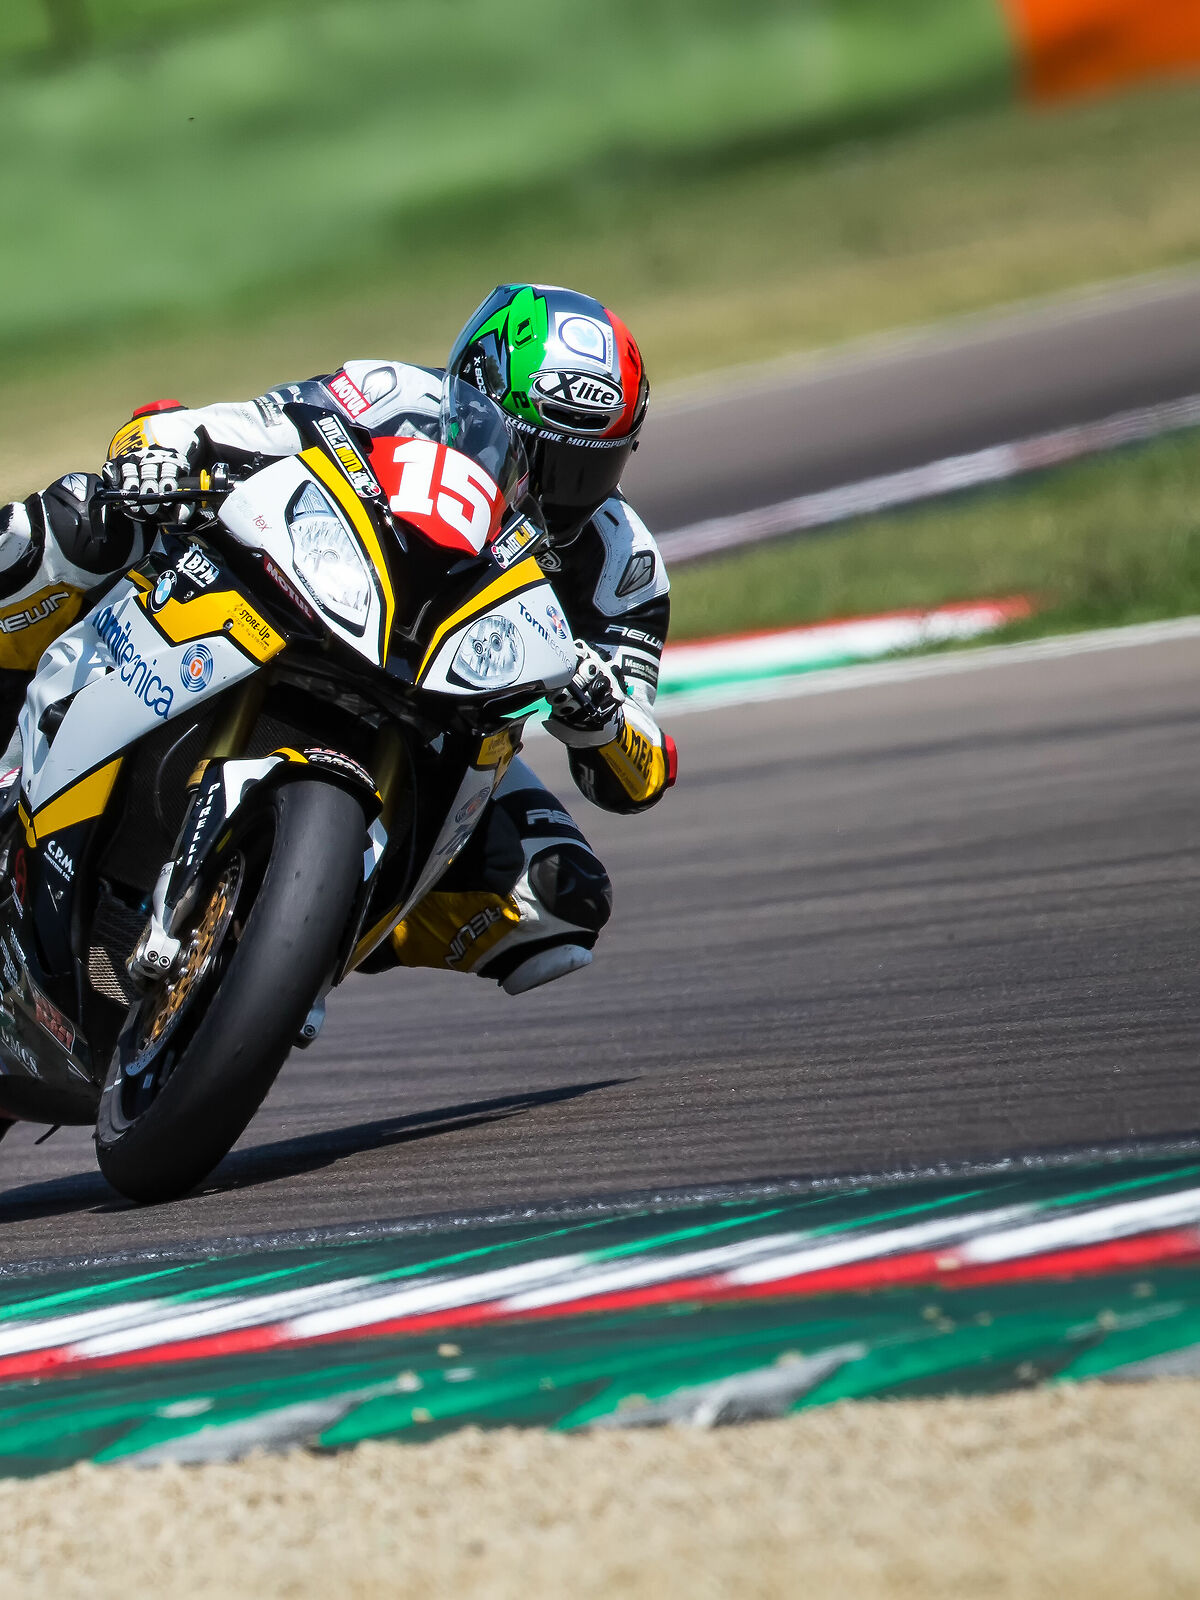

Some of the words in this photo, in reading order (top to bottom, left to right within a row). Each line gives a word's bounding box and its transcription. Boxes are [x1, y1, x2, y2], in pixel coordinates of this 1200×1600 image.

[330, 375, 368, 418] MOTUL
[545, 371, 616, 407] X-lite
[538, 430, 566, 443] ONE
[389, 439, 498, 556] 15
[186, 553, 218, 585] BFM
[266, 561, 314, 621] MOTUL
[186, 782, 220, 866] PIRELLI
[47, 840, 75, 876] C.P.M.
